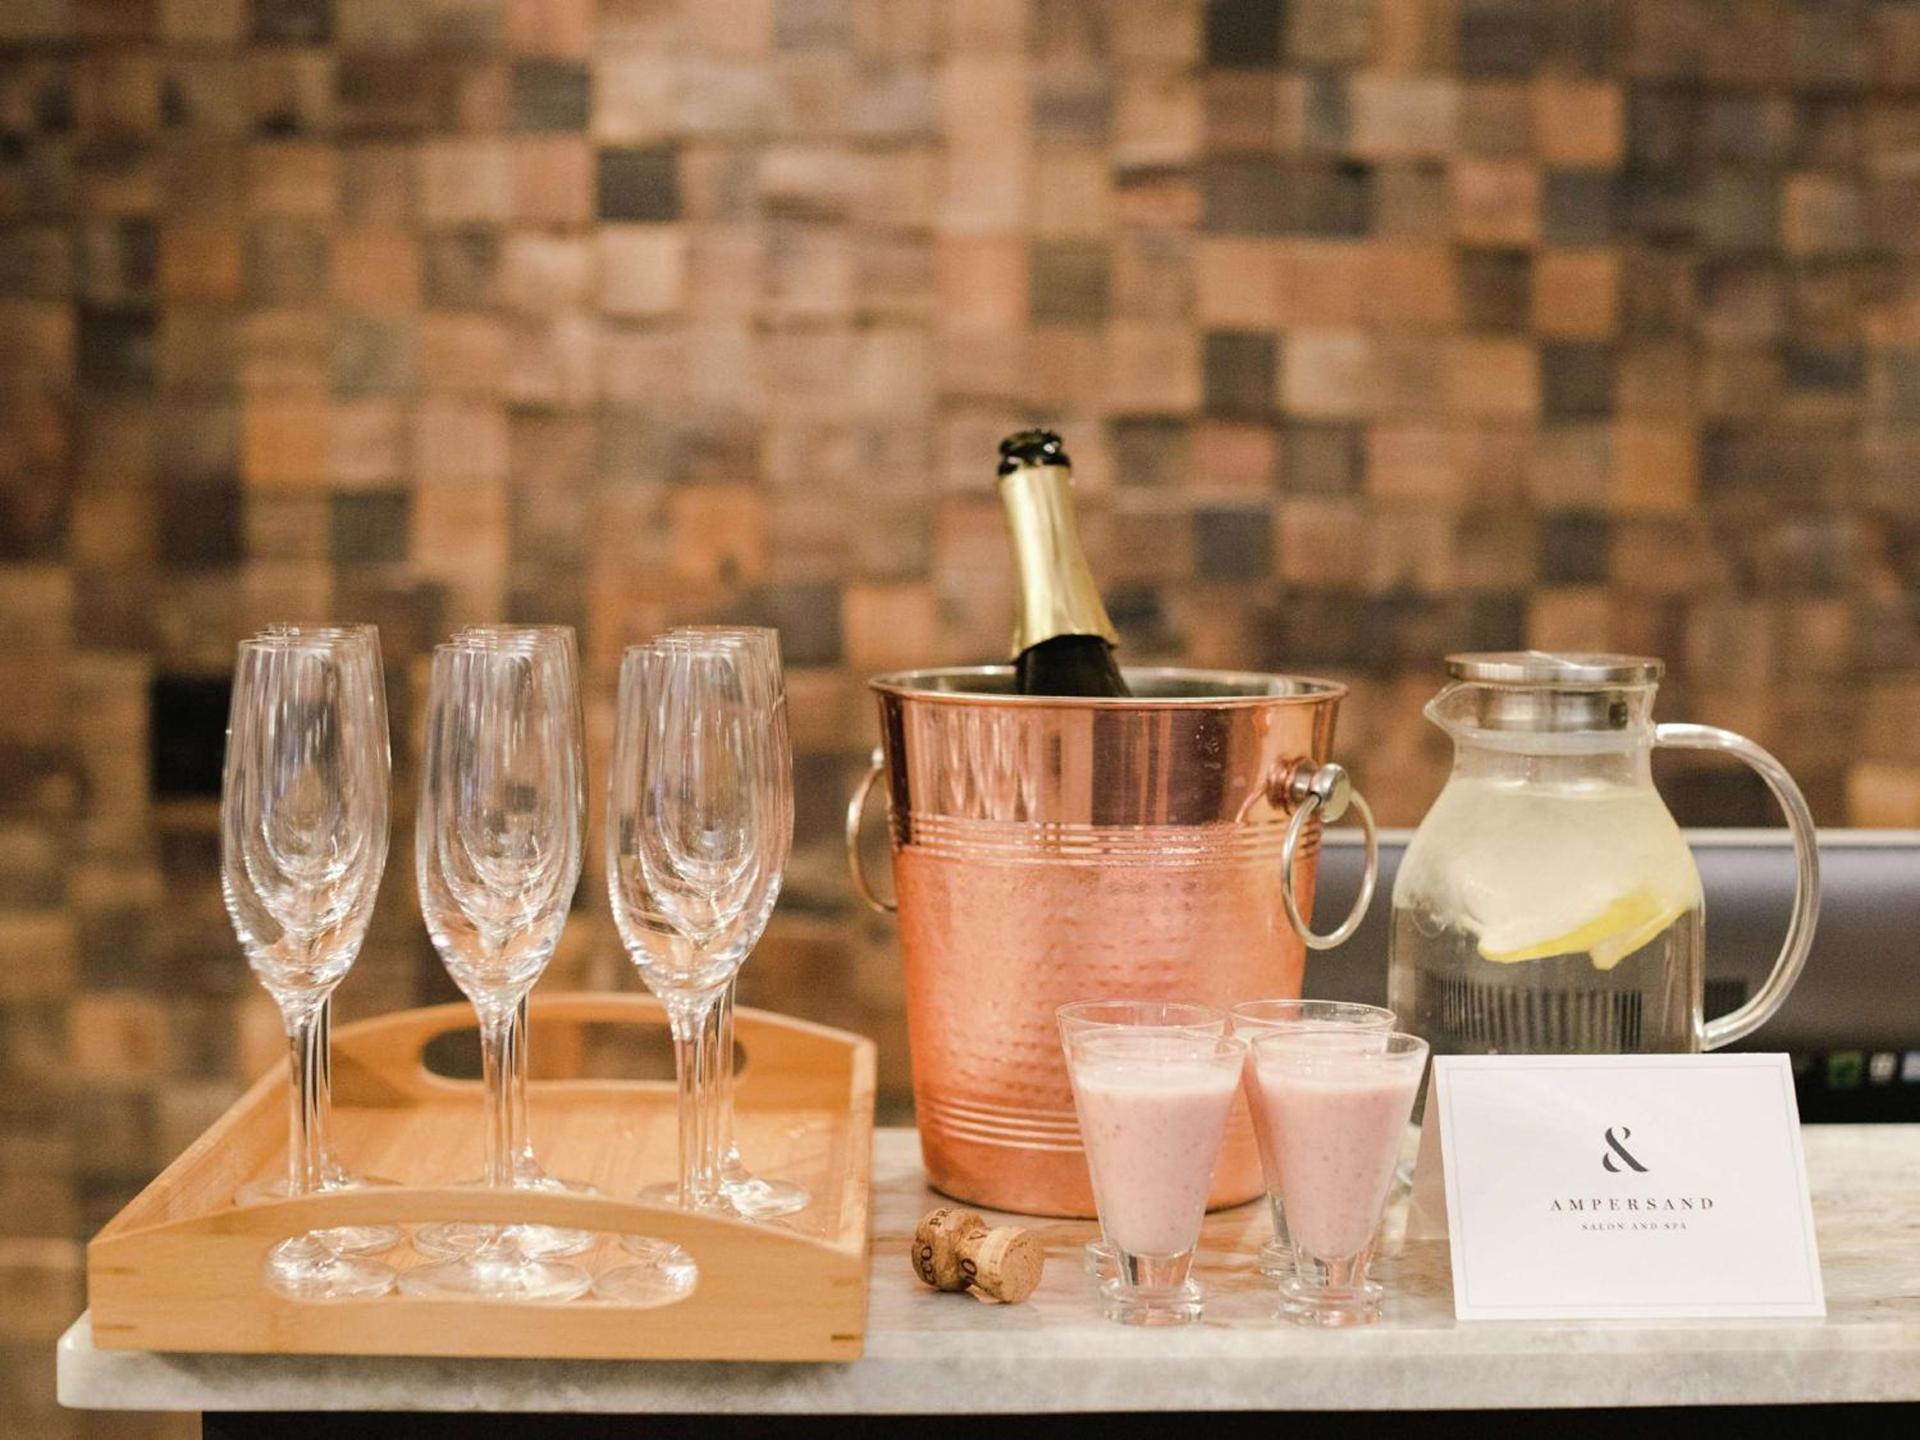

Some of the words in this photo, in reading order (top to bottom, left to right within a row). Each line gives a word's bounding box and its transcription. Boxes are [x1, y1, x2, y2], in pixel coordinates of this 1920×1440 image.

[1602, 1126, 1649, 1173] &
[1550, 1197, 1714, 1212] AMPERSAND
[1581, 1222, 1625, 1231] SALON
[1631, 1222, 1658, 1231] AND
[1663, 1222, 1687, 1231] SPA
